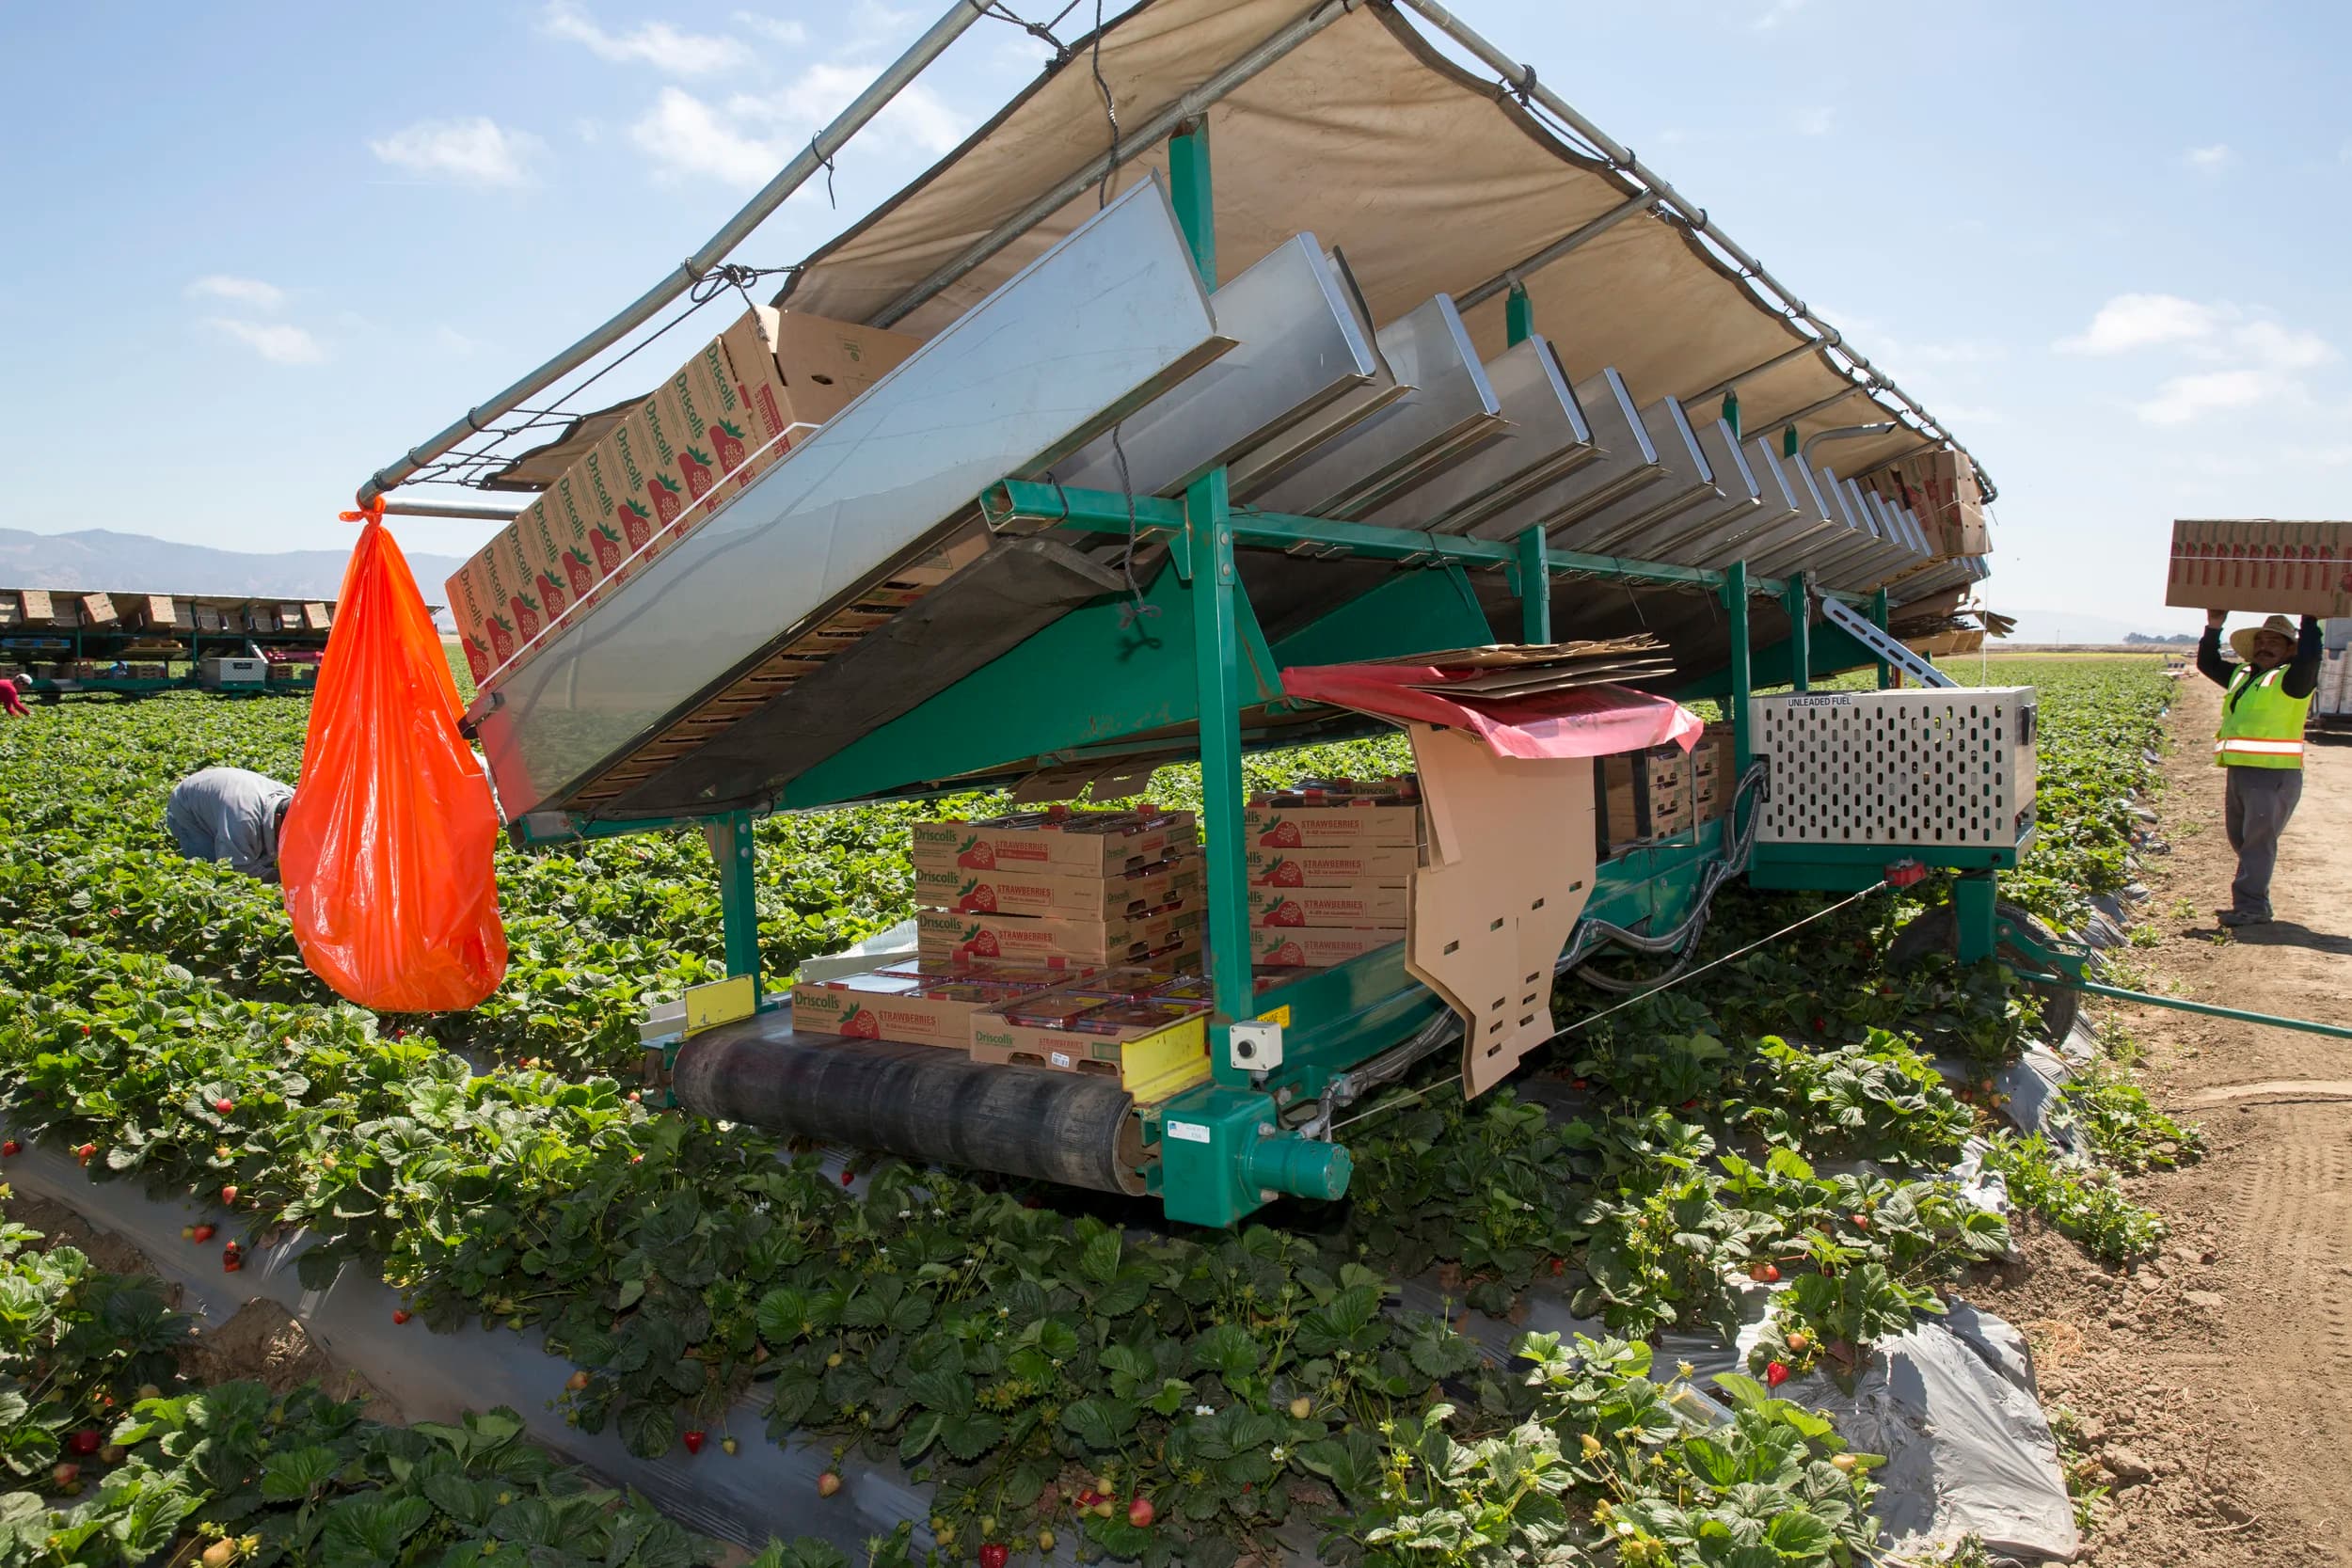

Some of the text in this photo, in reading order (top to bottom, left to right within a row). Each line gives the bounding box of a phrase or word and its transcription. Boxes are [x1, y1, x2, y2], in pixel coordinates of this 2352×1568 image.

[707, 343, 737, 412] Driscoll's
[675, 372, 705, 439] Driscoll's
[645, 400, 674, 466] Driscoll's
[616, 427, 644, 492] Driscoll's
[587, 451, 614, 516] Driscoll's
[559, 477, 586, 541] Driscoll's
[533, 501, 559, 563] Driscoll's
[508, 526, 533, 586] Driscoll's
[484, 547, 507, 608] Driscoll's
[460, 569, 484, 627] Driscoll's
[1788, 696, 1851, 706] UNLEADED FUEL
[1301, 819, 1359, 829] STRAWBERRIES
[914, 828, 957, 843] Driscoll's
[994, 840, 1048, 851] STRAWBERRIES
[1303, 859, 1361, 868] STRAWBERRIES
[915, 869, 959, 884] Driscoll's
[996, 884, 1051, 897] STRAWBERRIES
[1304, 899, 1363, 910] STRAWBERRIES
[919, 914, 962, 930] Driscoll's
[998, 930, 1053, 941] STRAWBERRIES
[794, 990, 840, 1009] Driscoll's
[879, 1010, 936, 1025] STRAWBERRIES
[976, 1031, 1014, 1045] Driscoll's
